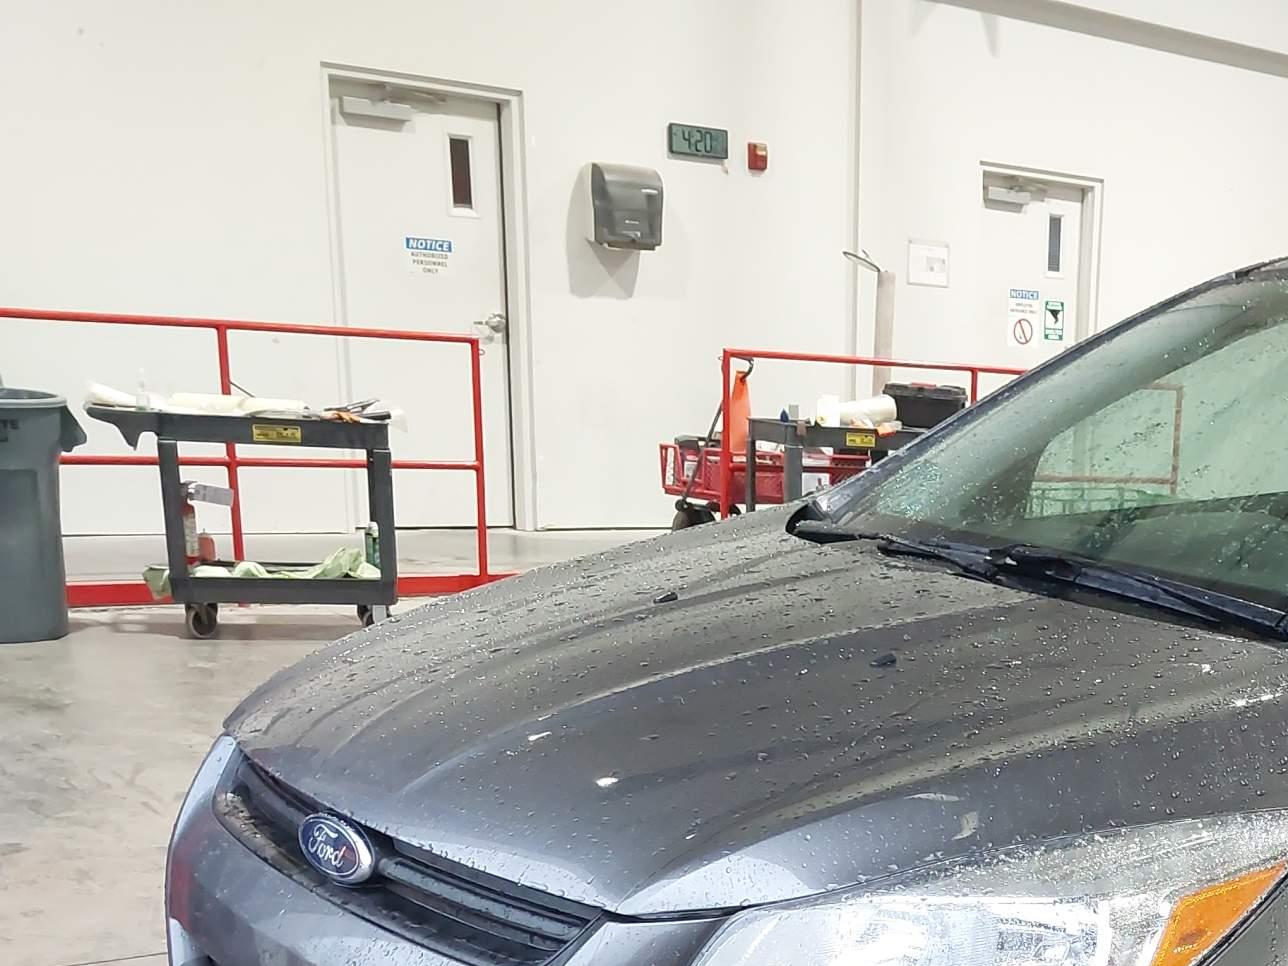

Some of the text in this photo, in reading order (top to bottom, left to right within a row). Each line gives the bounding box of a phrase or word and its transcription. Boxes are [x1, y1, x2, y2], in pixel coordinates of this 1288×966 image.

[408, 238, 450, 251] NOTICE
[1010, 289, 1038, 300] NOTICE
[308, 824, 347, 868] Ford
